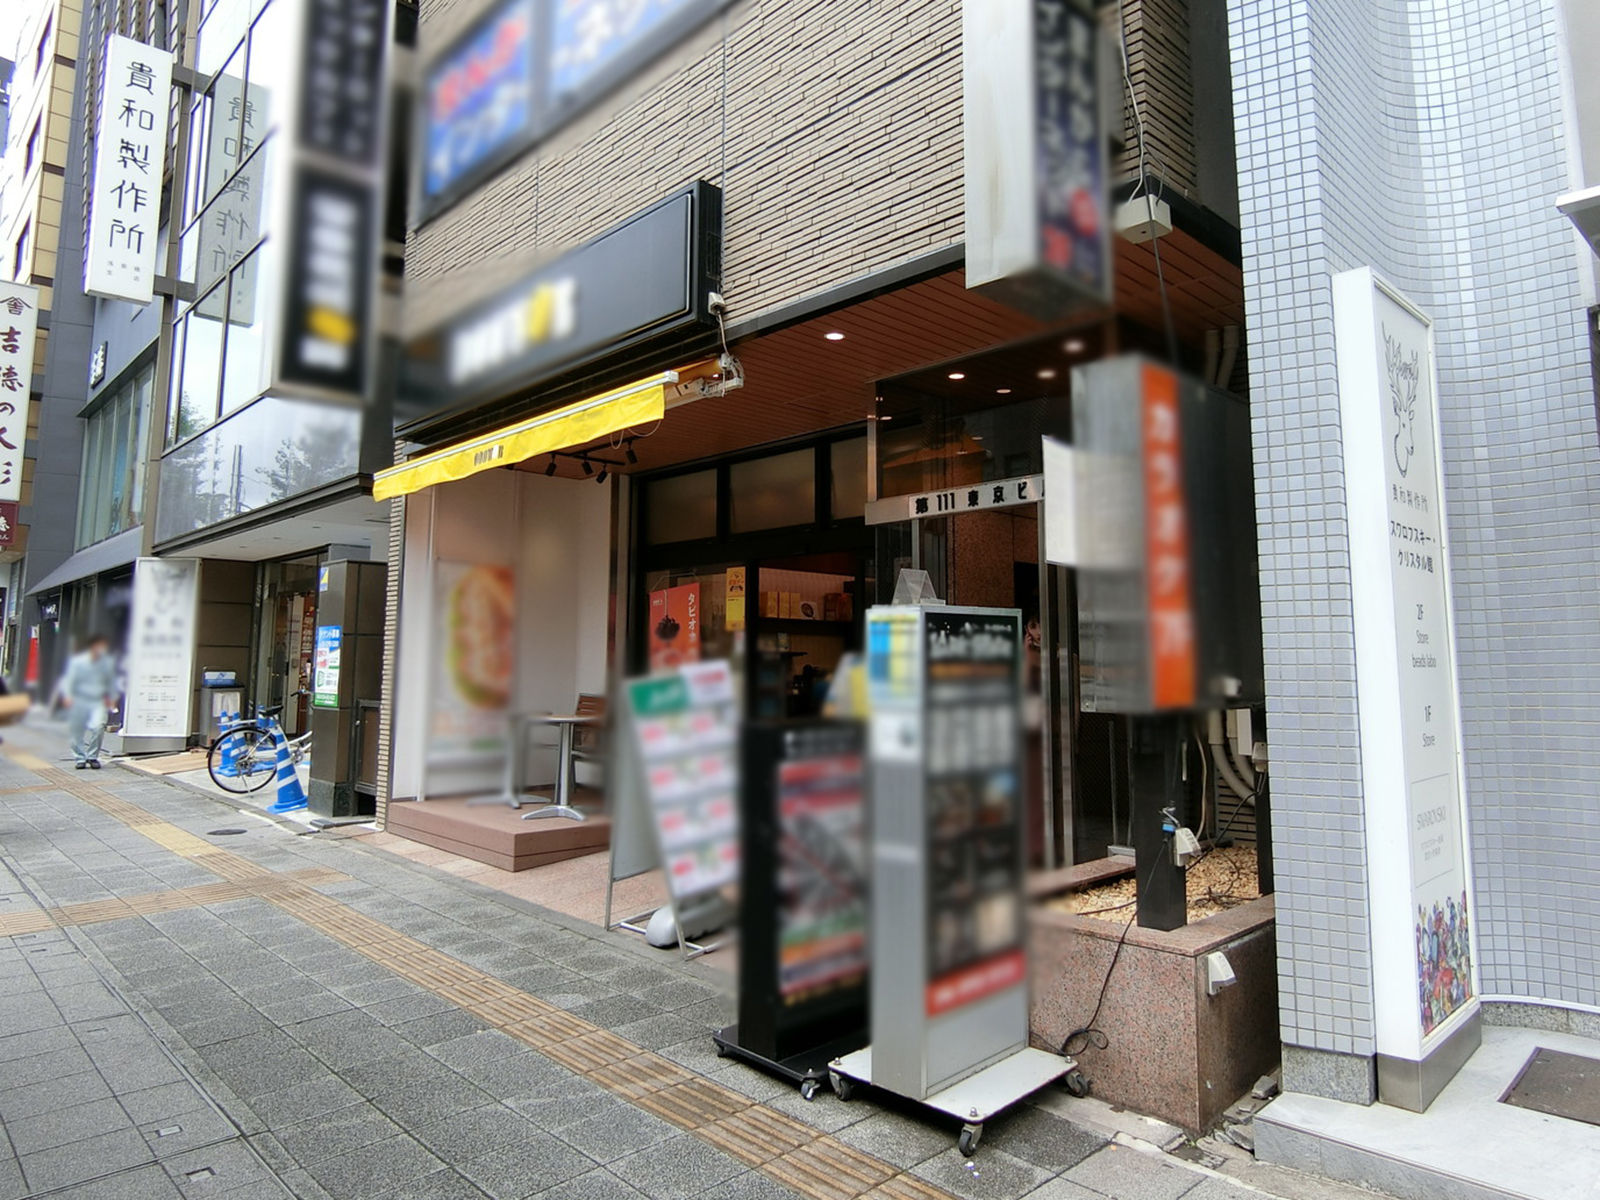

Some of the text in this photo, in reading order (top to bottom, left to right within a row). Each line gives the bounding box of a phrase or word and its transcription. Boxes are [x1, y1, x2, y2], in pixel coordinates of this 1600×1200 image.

[109, 61, 157, 254] 貴和製作所
[915, 480, 1044, 514] 第111東京ビ
[1398, 549, 1433, 573] クリスタル館
[1416, 604, 1424, 620] 2F
[1416, 630, 1429, 644] Store
[1412, 654, 1426, 668] beads
[1424, 705, 1432, 722] 1F
[1423, 733, 1435, 747] Store
